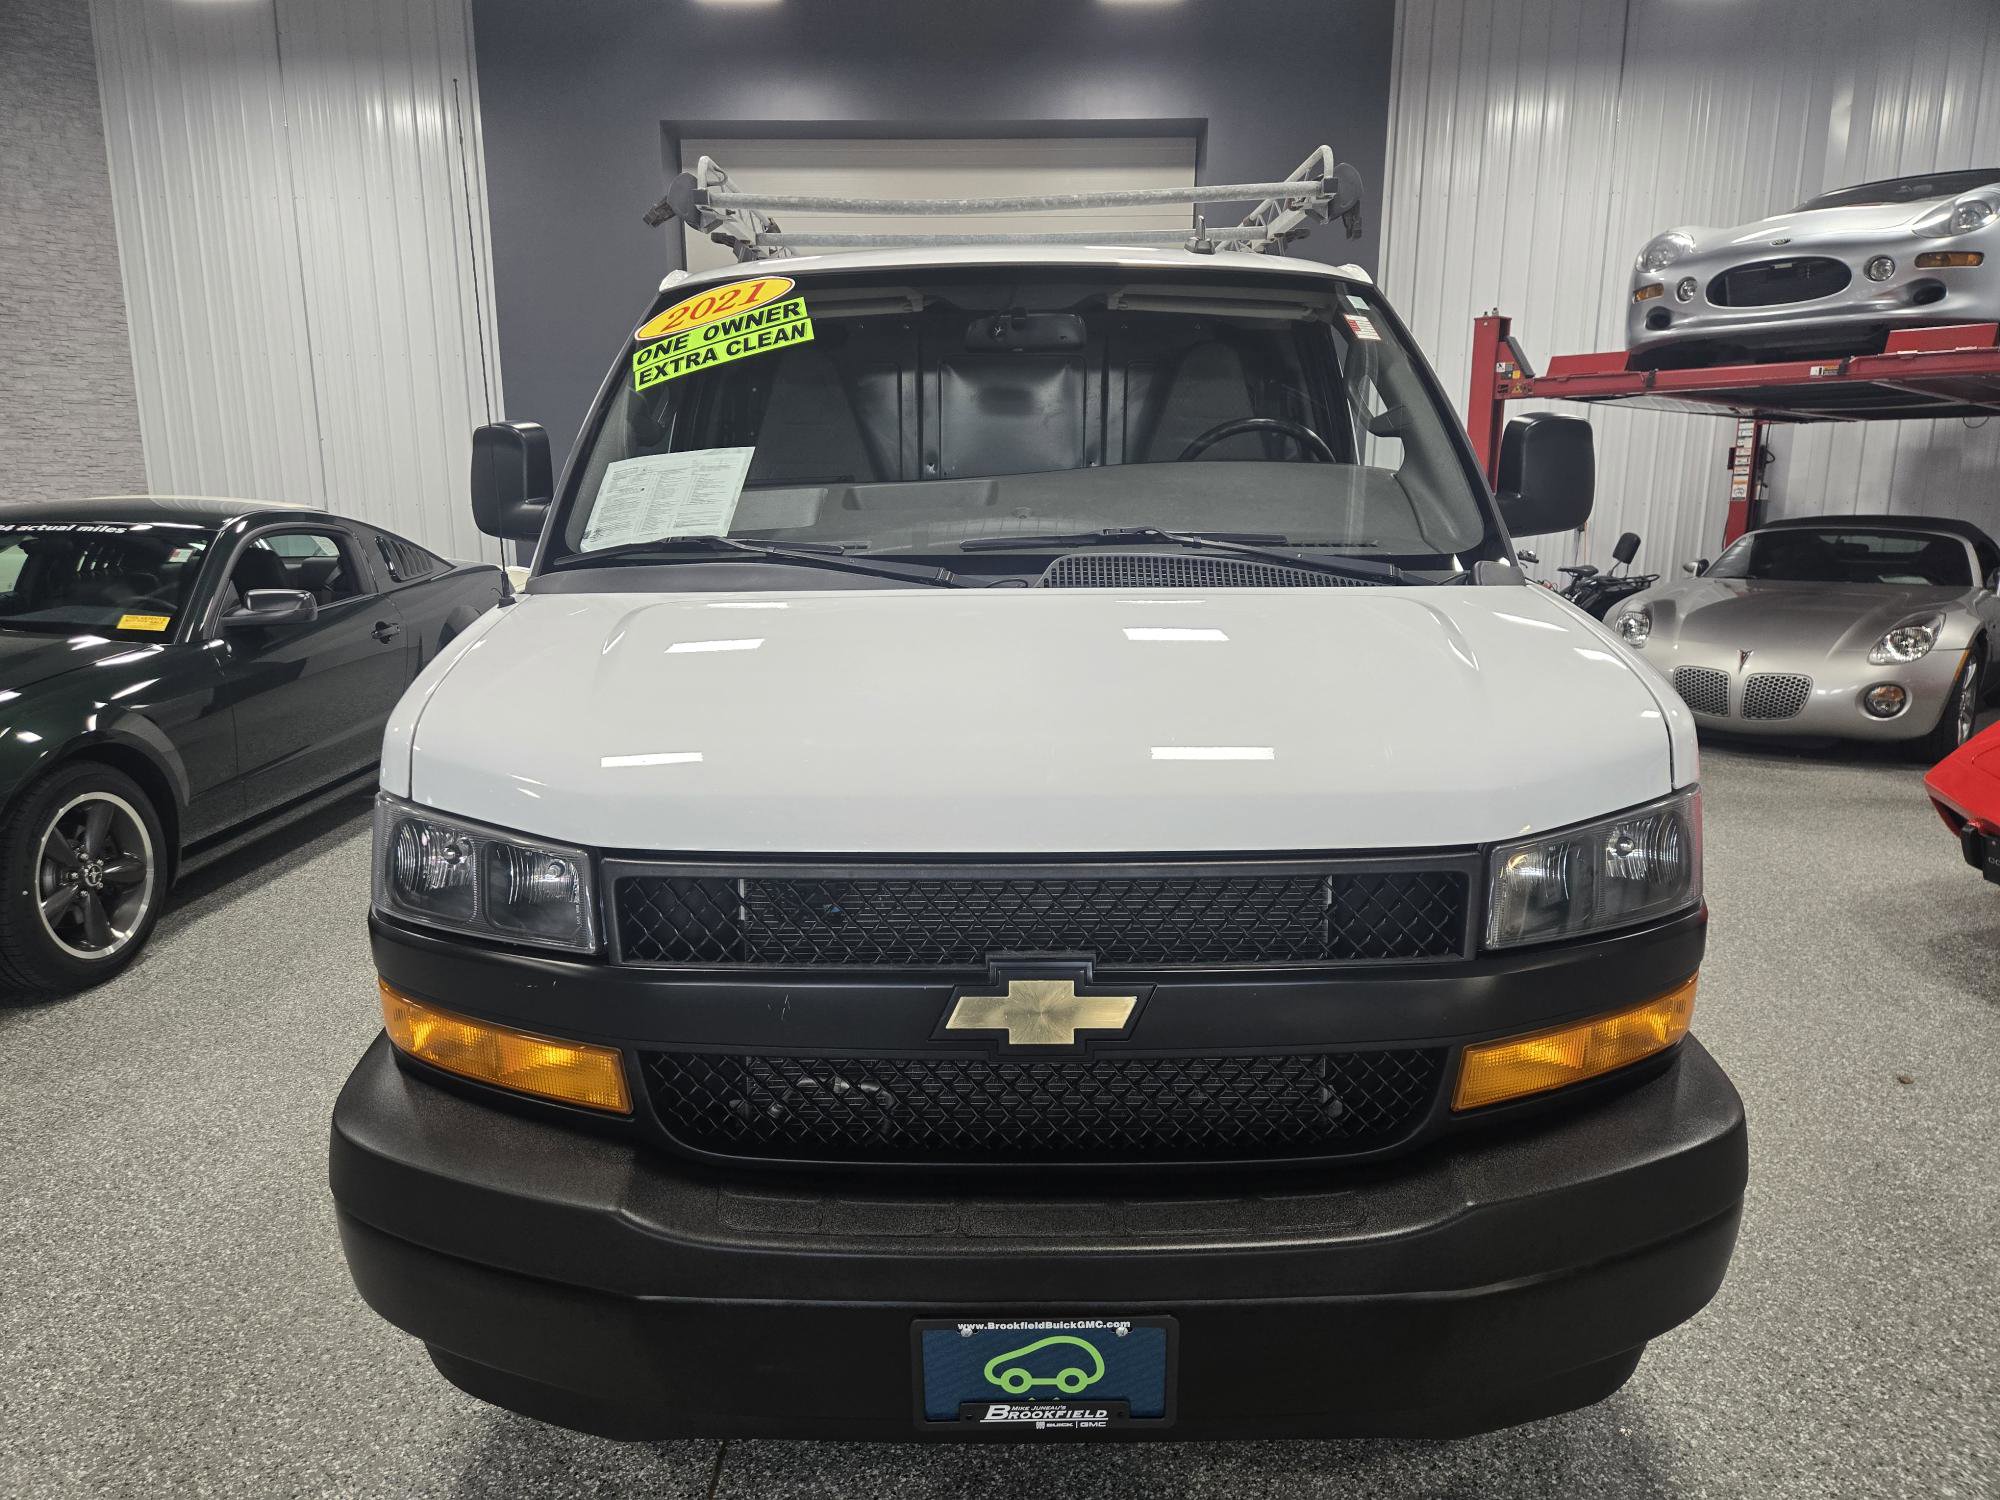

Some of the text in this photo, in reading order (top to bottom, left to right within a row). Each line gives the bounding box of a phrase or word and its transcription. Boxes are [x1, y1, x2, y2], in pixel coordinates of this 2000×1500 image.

[661, 282, 767, 332] 2021
[637, 302, 801, 366] ONE OWNER
[639, 322, 806, 386] EXTRA CLEAN
[77, 525, 128, 533] miles
[957, 1321, 1131, 1330] www.BrookfieldBuickGMC.com
[984, 1405, 1108, 1419] BROOKFIELD
